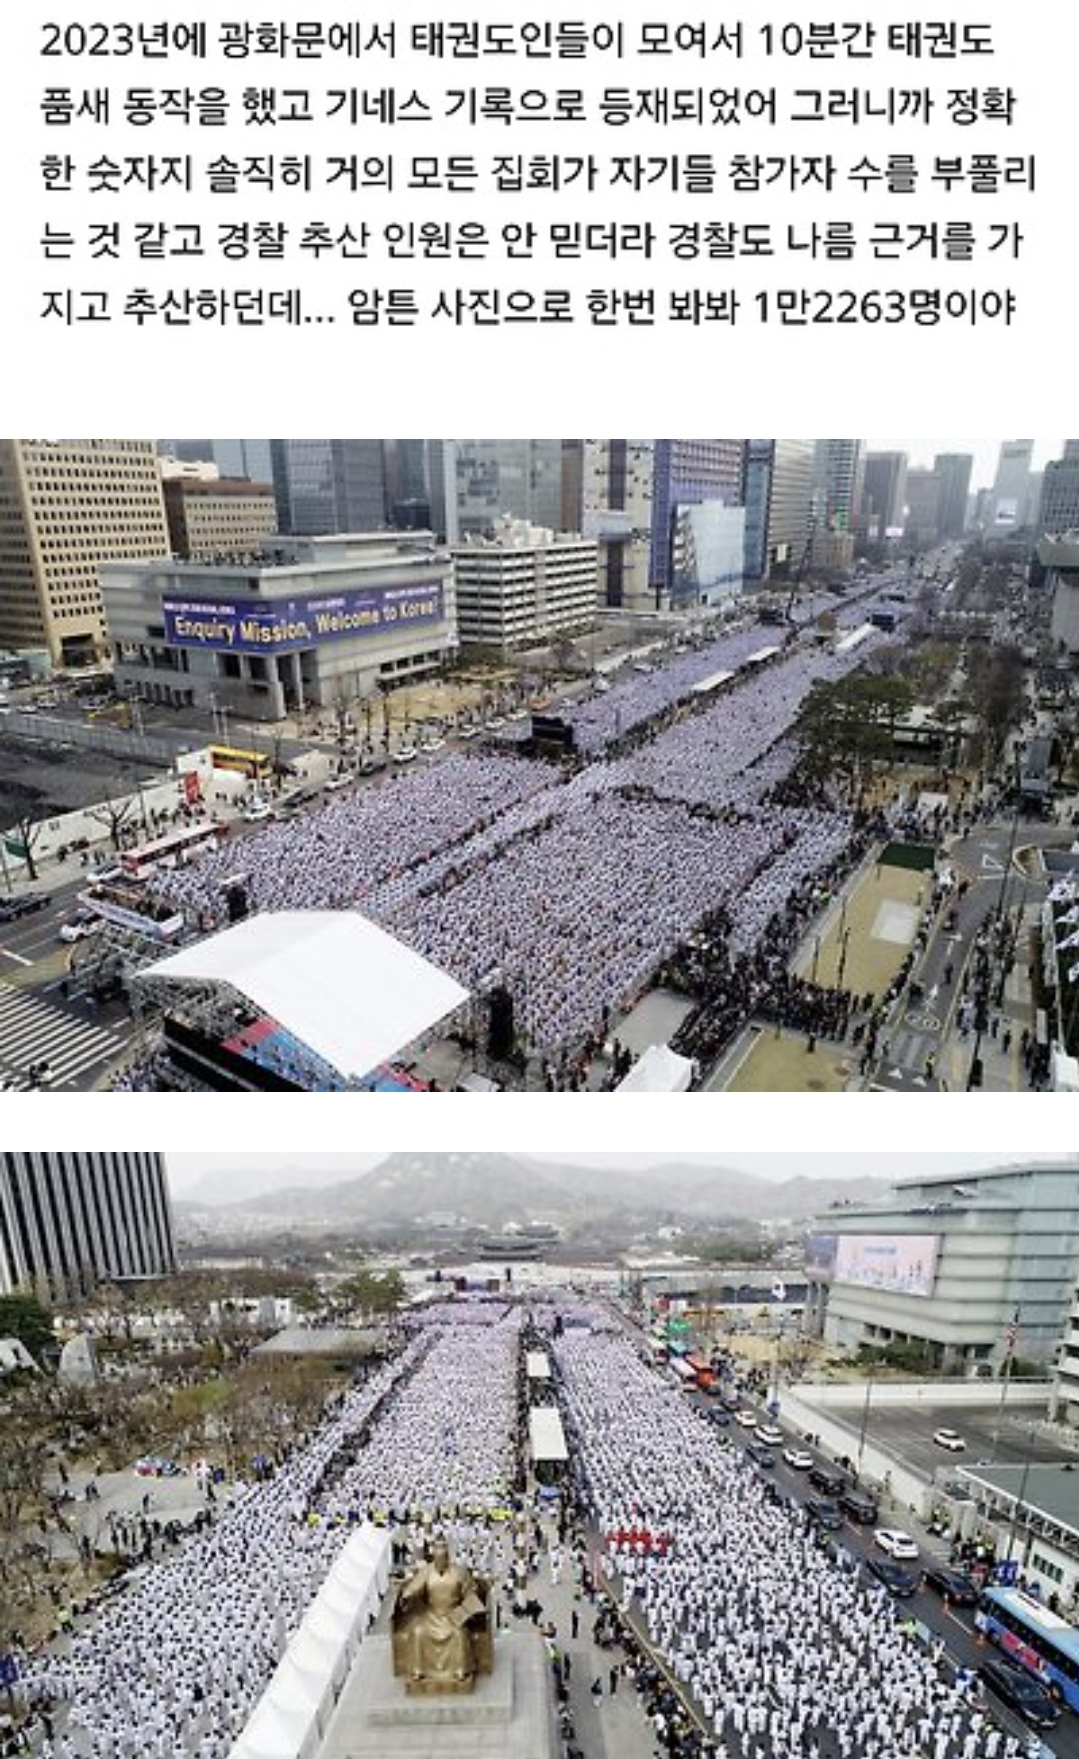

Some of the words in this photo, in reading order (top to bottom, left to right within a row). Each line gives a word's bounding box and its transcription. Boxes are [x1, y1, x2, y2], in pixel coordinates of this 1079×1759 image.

[175, 616, 235, 645] Enquiry
[240, 619, 311, 642] Mission,
[315, 610, 379, 634] Welcome
[383, 604, 398, 621] to
